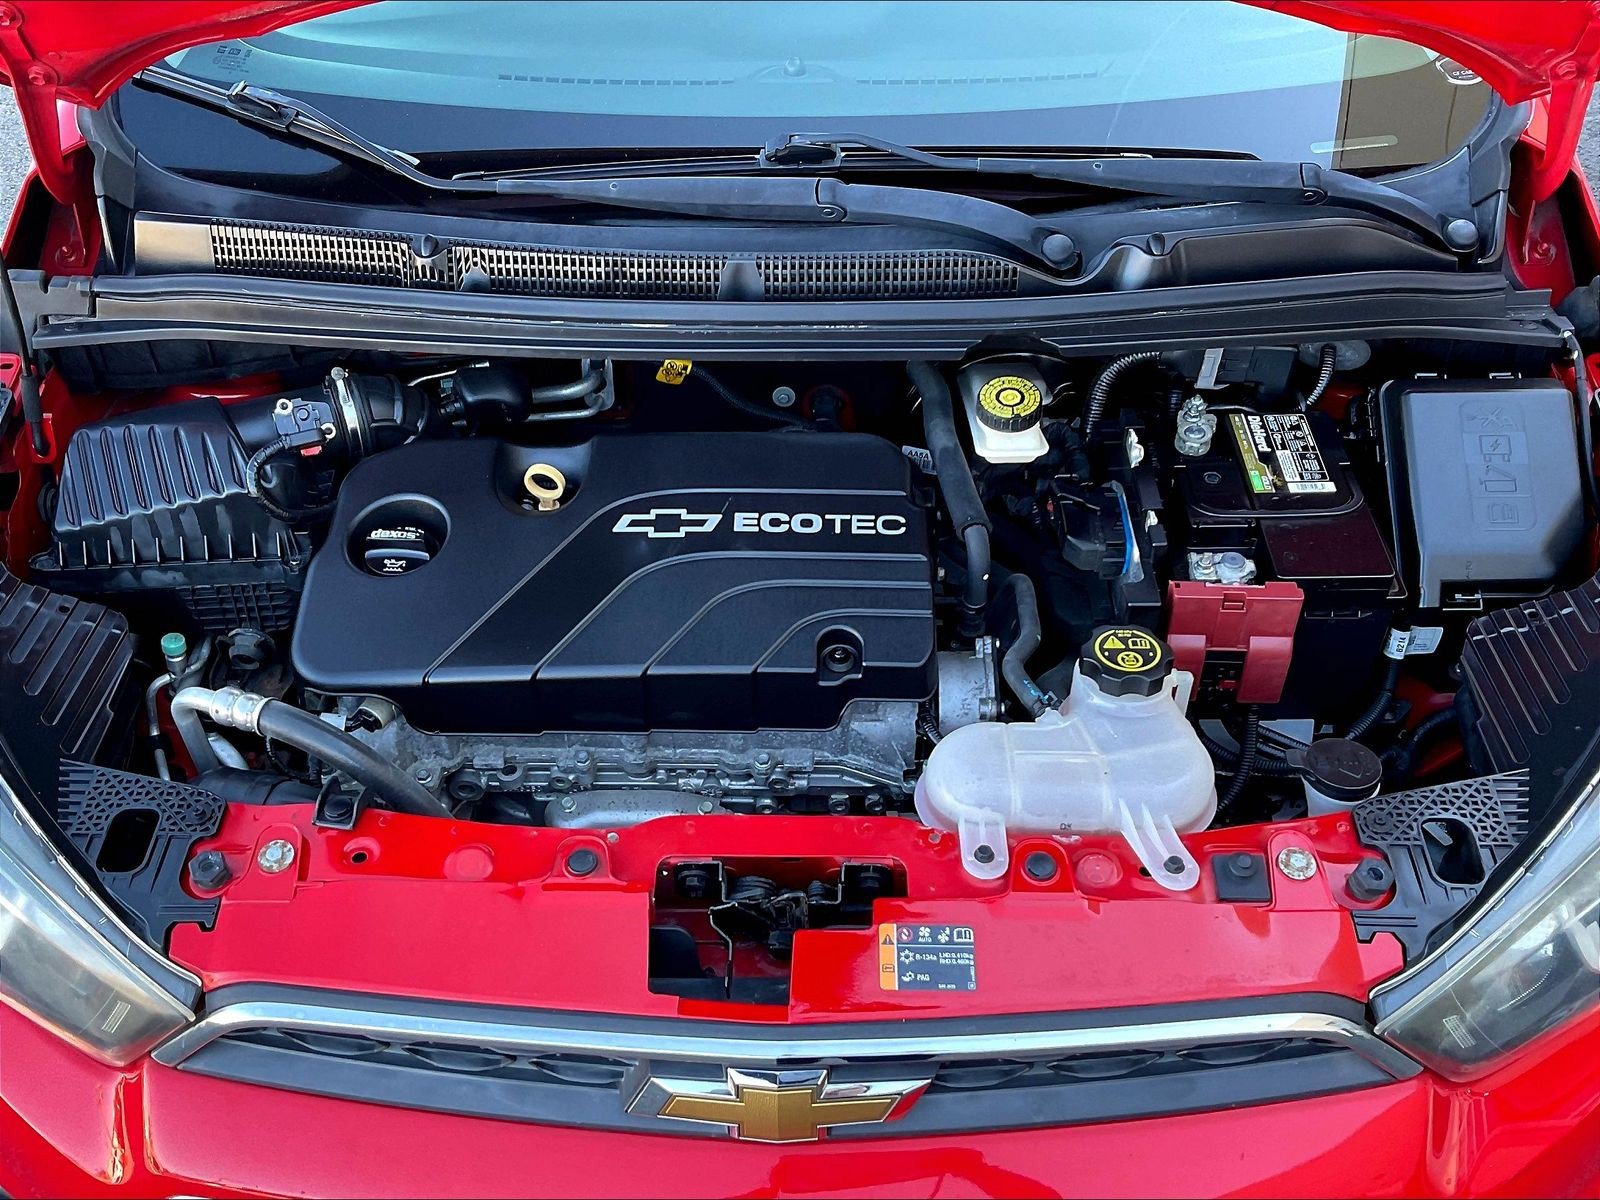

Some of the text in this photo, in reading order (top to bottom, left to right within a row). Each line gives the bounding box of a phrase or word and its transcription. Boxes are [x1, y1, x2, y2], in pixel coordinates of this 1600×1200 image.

[1248, 415, 1272, 451] DieHard
[371, 529, 416, 539] dexos
[733, 512, 907, 535] ECOTEC
